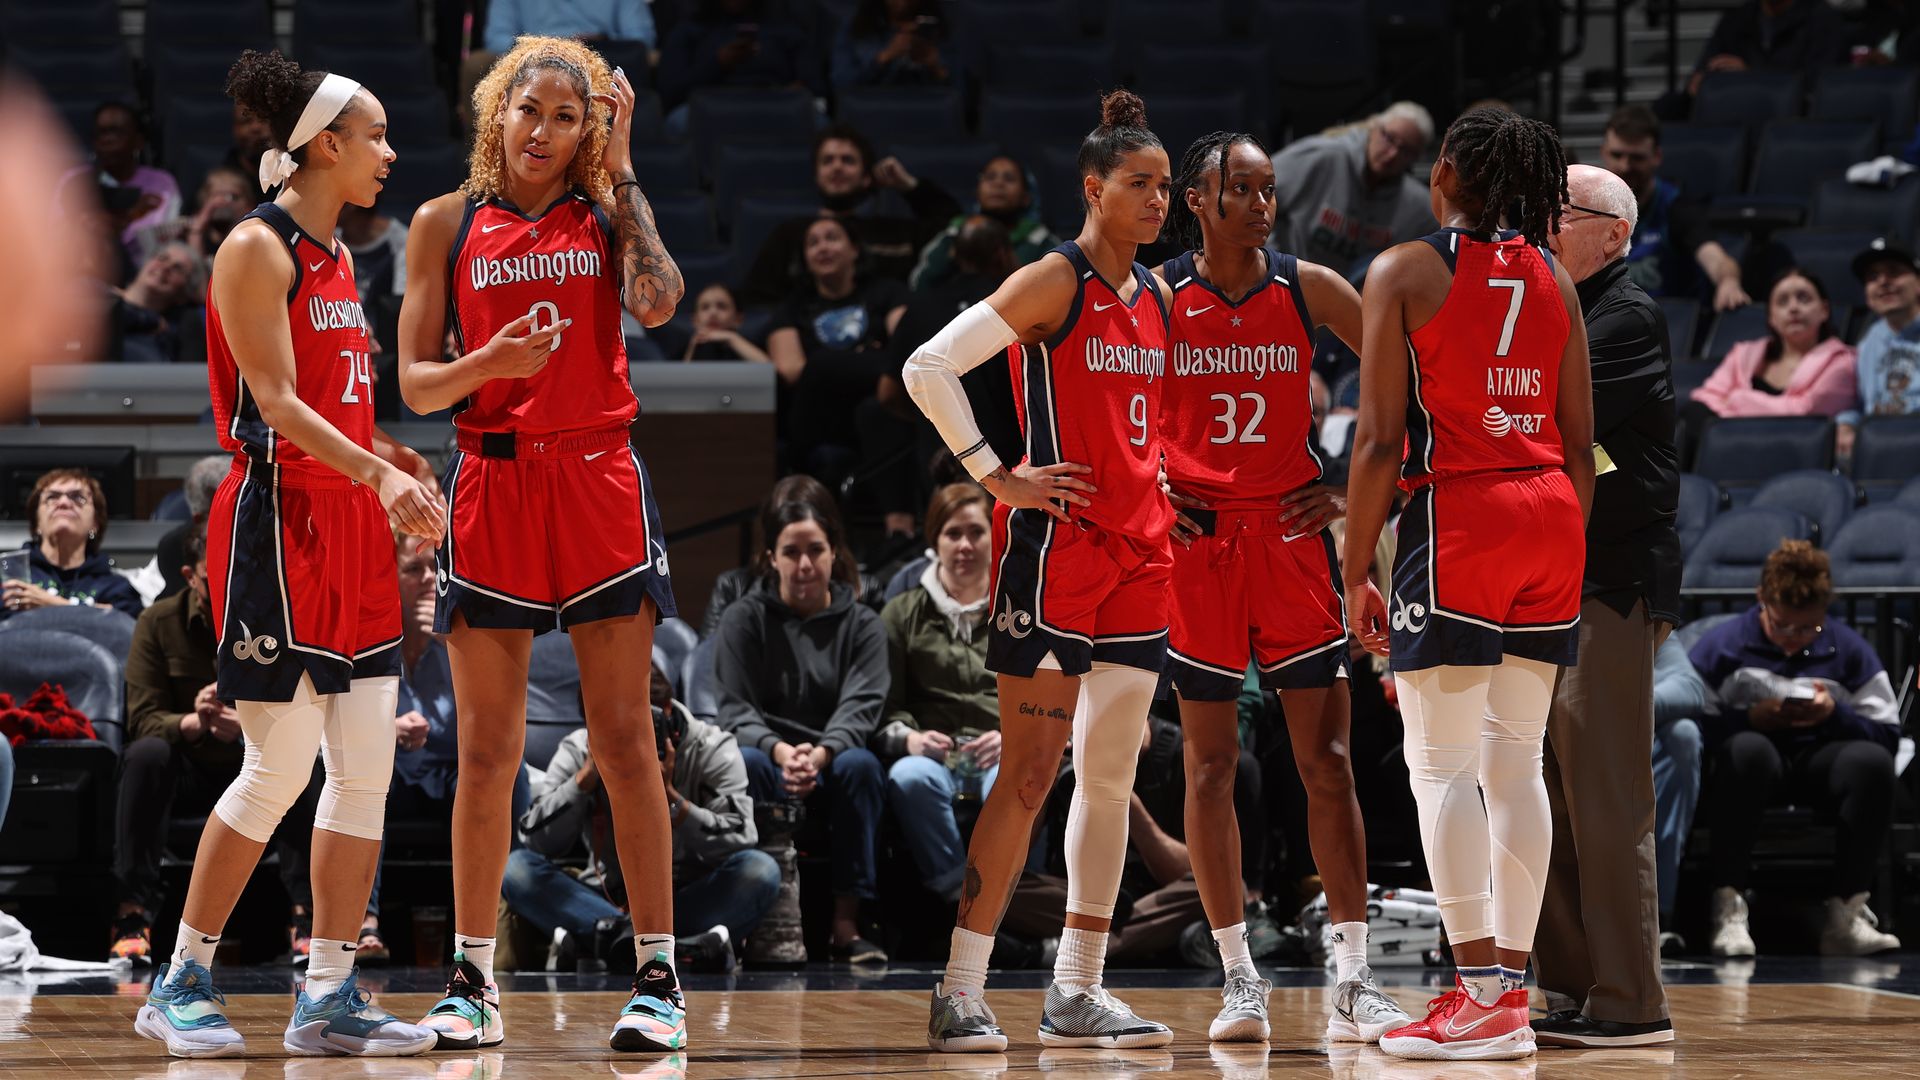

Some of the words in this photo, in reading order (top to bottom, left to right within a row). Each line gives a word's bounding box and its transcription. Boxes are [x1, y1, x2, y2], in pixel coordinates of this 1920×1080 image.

[472, 248, 602, 291] Washington
[1488, 278, 1526, 357] 7
[340, 349, 372, 405] 24
[1173, 340, 1299, 381] Washington
[1487, 367, 1542, 397] ATKINS
[1129, 394, 1148, 446] 9
[1210, 392, 1267, 444] 32
[1019, 702, 1037, 717] God
[1038, 707, 1045, 716] is
